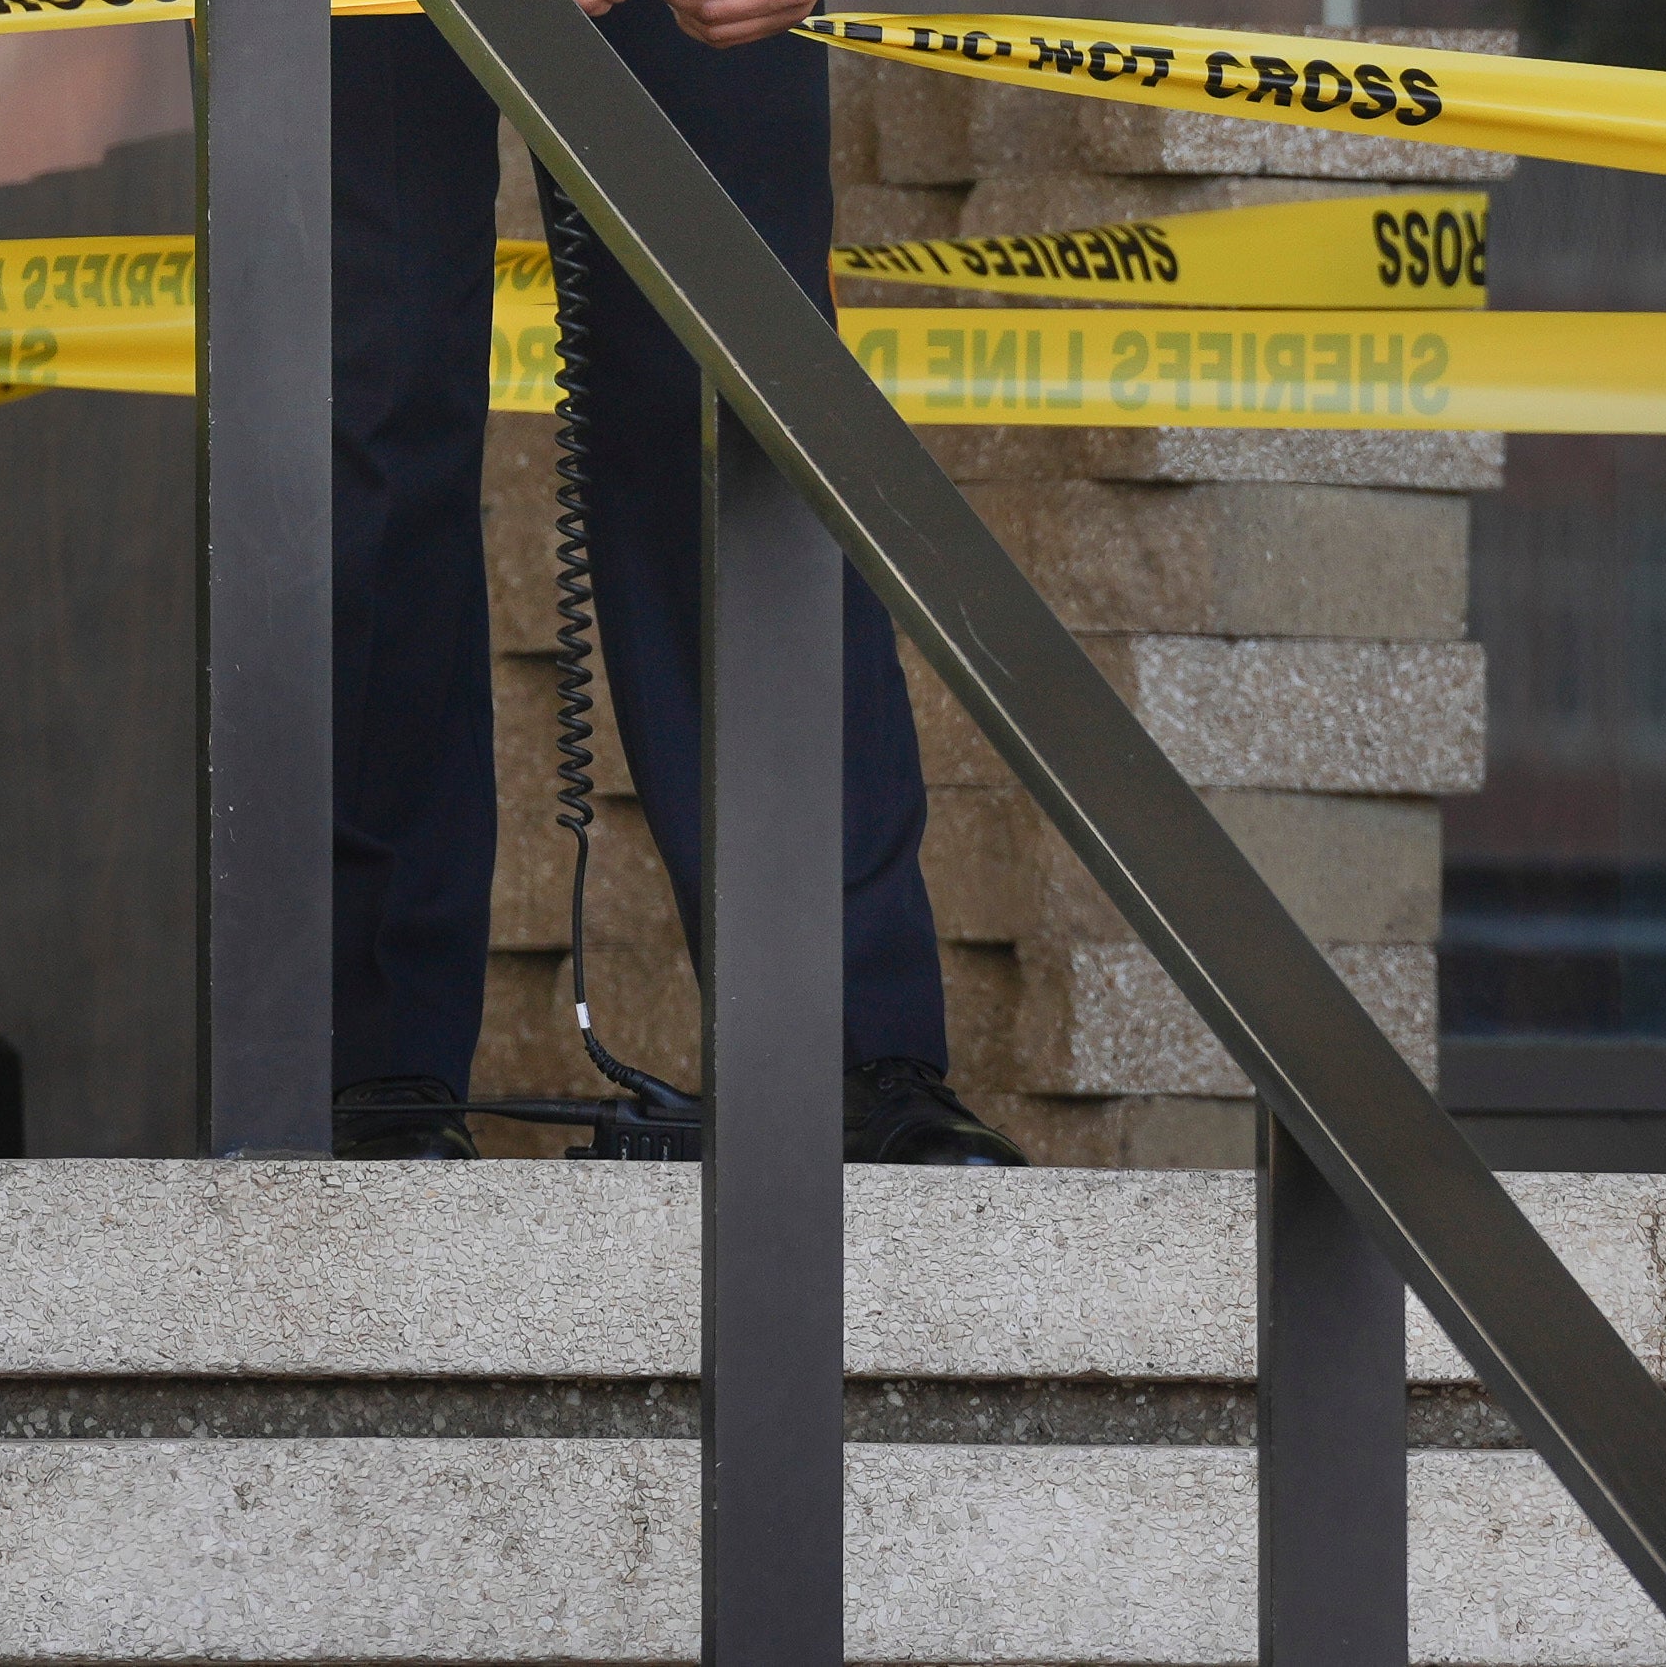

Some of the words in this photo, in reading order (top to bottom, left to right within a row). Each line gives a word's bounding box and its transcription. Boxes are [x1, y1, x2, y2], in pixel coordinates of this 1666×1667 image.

[908, 26, 1012, 62] DO
[1029, 36, 1175, 87] NOT
[1205, 50, 1443, 127] CROSS
[949, 222, 1178, 283] SHERIFFS
[1373, 208, 1486, 287] ROSS
